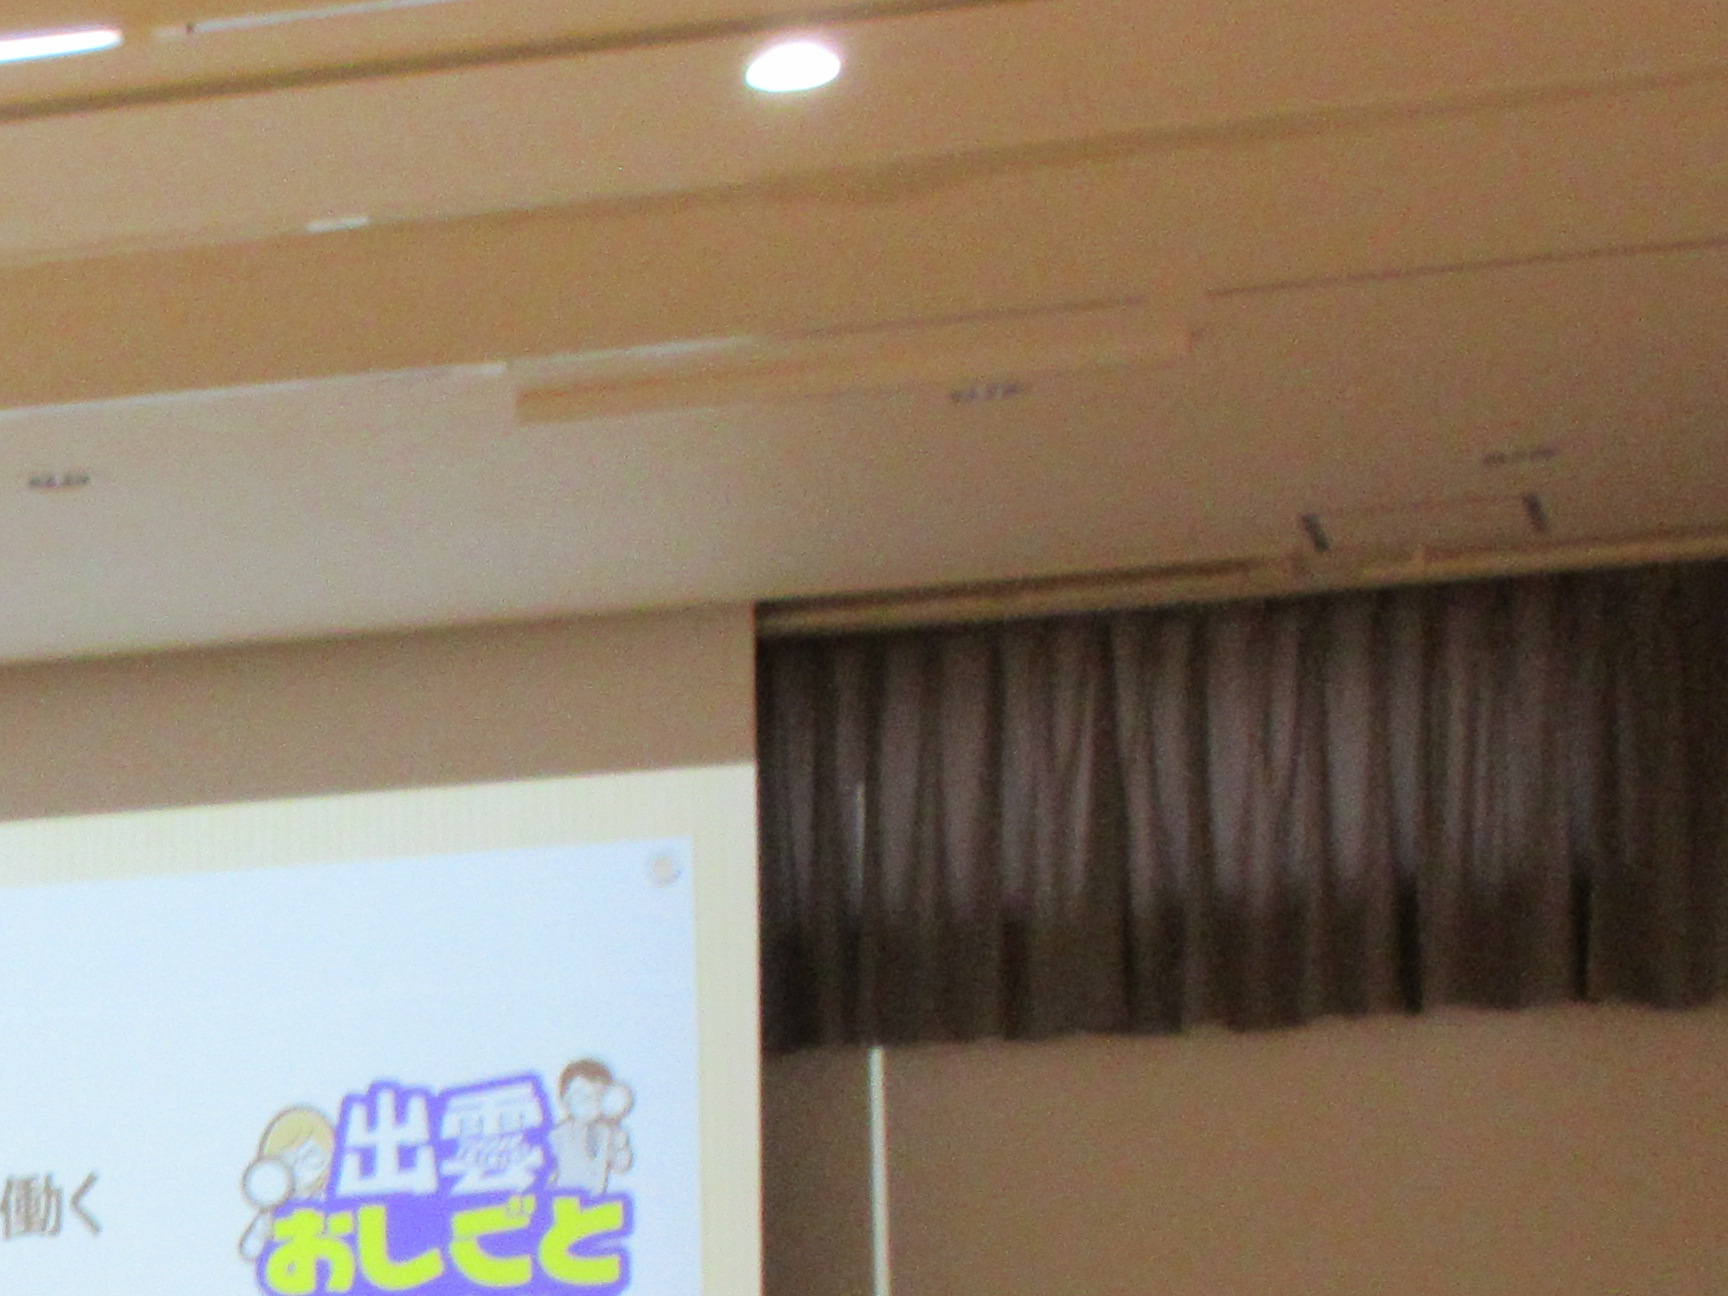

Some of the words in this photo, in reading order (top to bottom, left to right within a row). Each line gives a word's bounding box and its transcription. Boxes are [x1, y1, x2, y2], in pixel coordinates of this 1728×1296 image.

[337, 1083, 543, 1197] 出雲
[264, 1195, 624, 1296] おしごと
